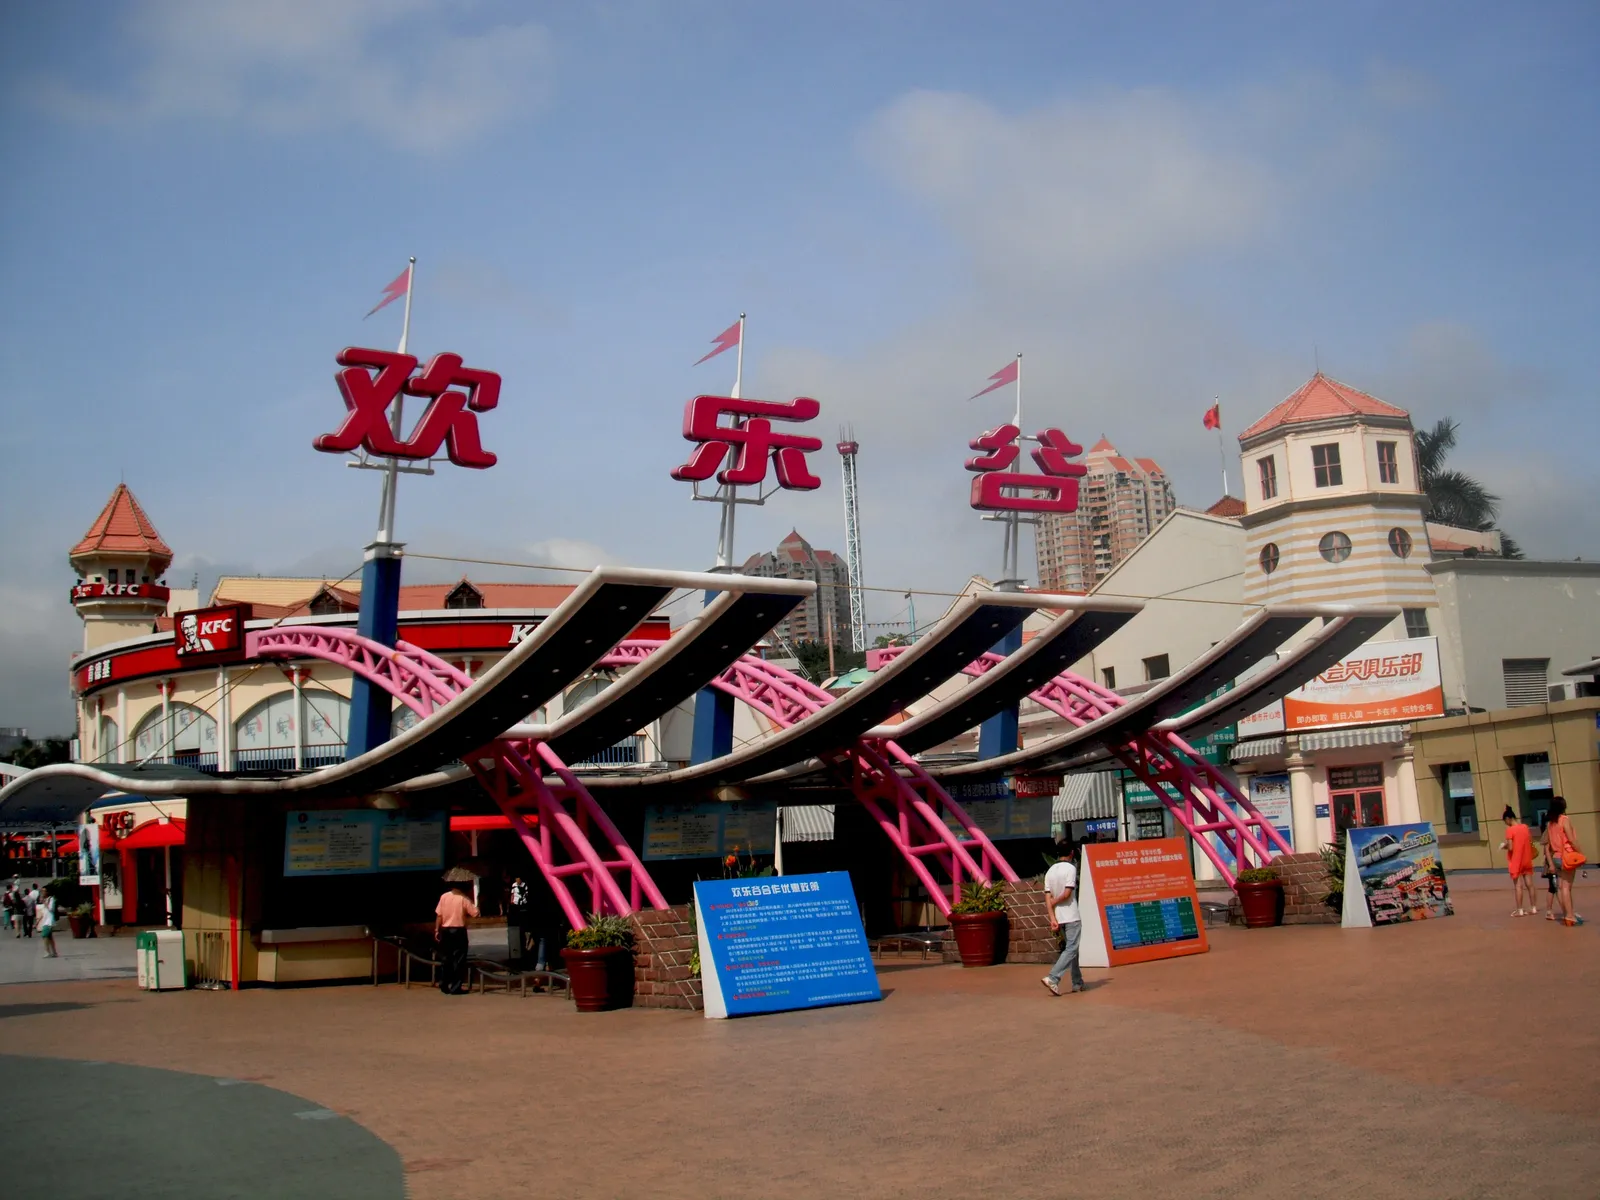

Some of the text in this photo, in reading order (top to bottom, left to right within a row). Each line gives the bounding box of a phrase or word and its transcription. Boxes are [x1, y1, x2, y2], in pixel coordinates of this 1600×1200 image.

[312, 346, 1088, 513] 欢 乐 谷
[101, 584, 140, 596] KFC
[200, 618, 233, 635] KFC
[1296, 703, 1434, 725] 即办即取 当日入园 一卡在手 玩转全年
[730, 881, 820, 898] 欢乐谷合作优惠政策
